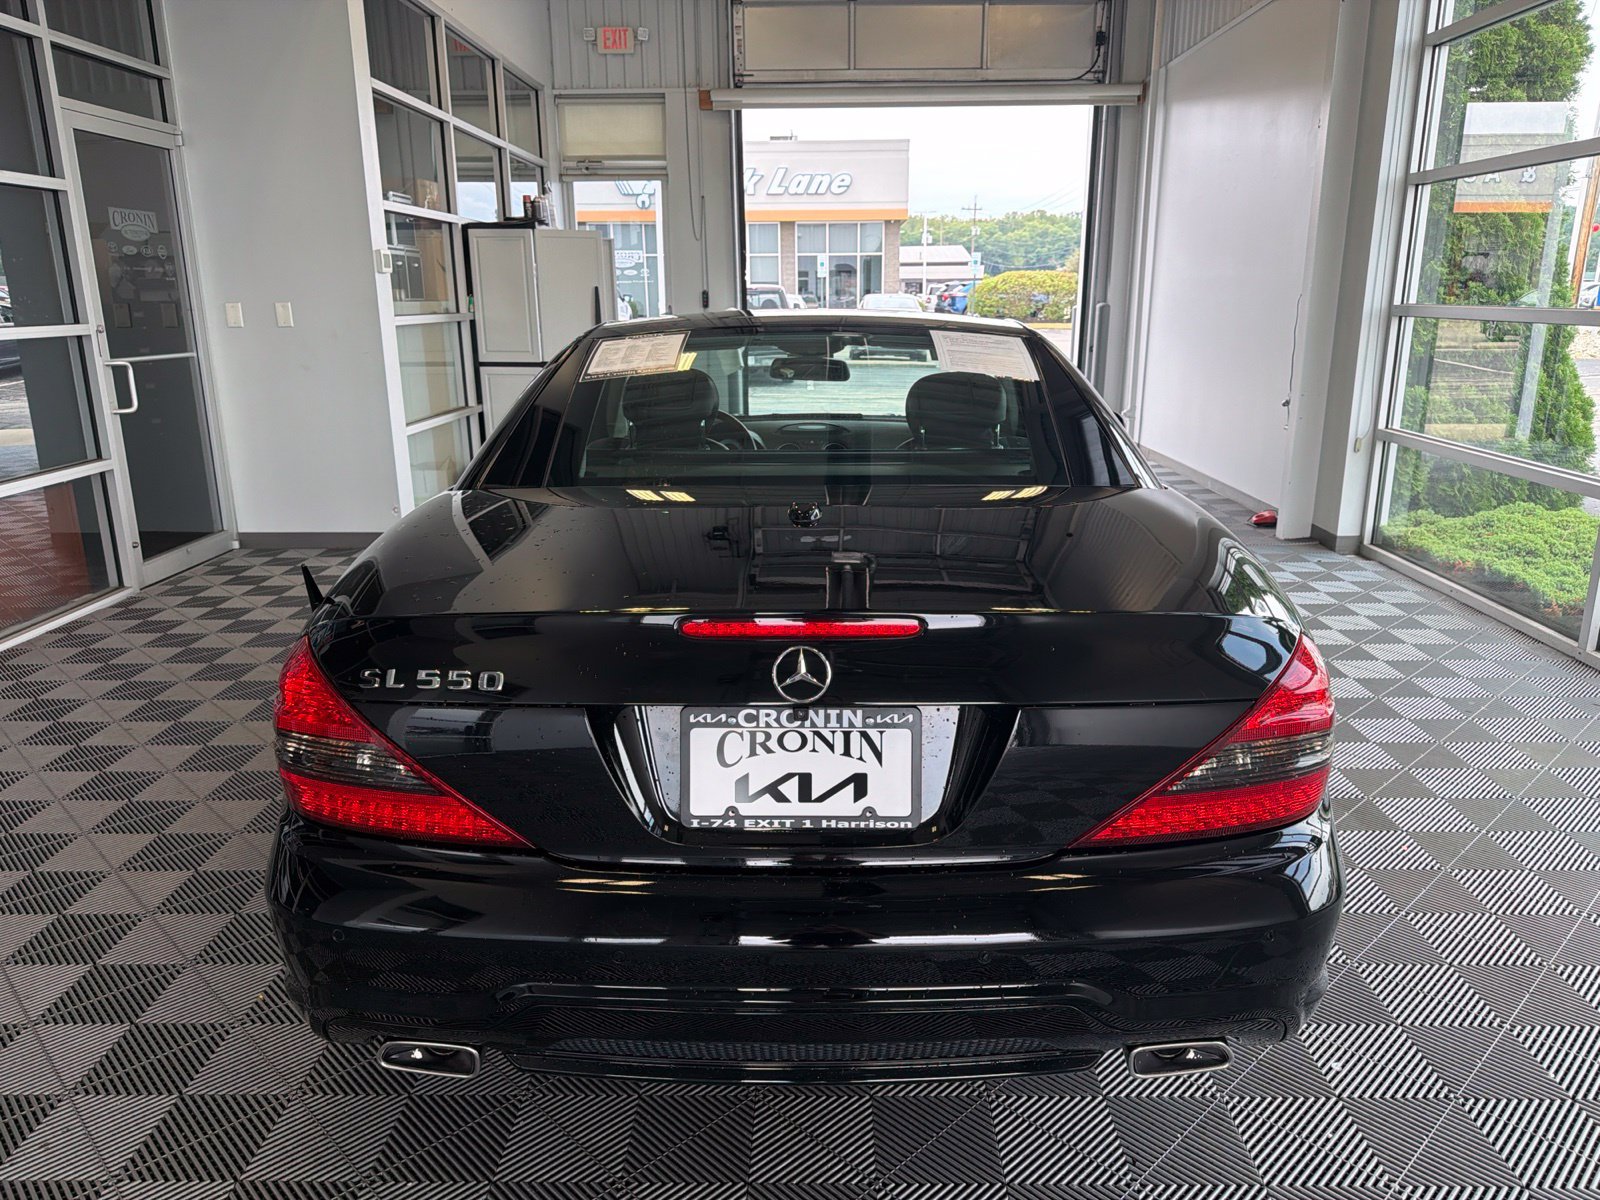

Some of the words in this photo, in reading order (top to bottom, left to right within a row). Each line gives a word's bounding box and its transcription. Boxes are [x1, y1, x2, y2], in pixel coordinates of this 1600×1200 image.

[602, 27, 628, 49] EXIT
[766, 166, 853, 196] Lane
[112, 210, 155, 231] CRONIN
[358, 668, 405, 689] SL
[416, 669, 505, 691] 550
[737, 709, 863, 728] CRONIN
[716, 729, 886, 768] CRONIN
[690, 819, 737, 828] I-74
[744, 819, 794, 828] EXIT
[802, 819, 813, 828] 1
[821, 819, 912, 828] Harrison
